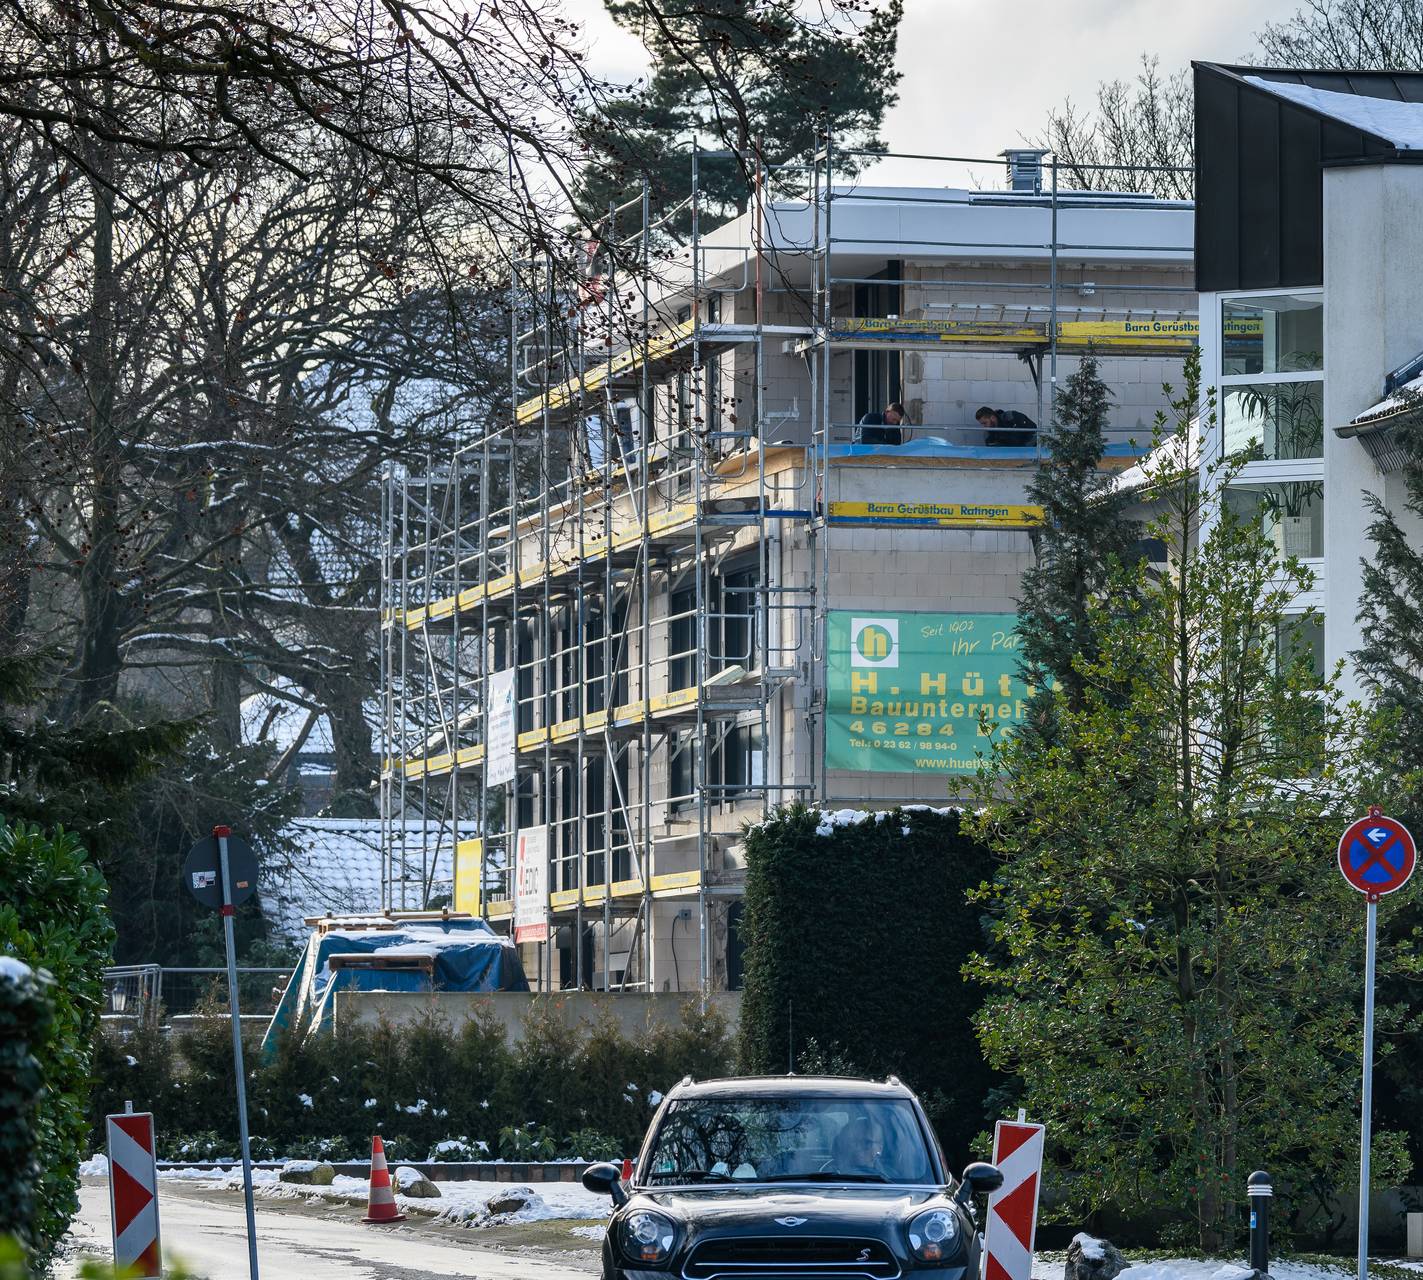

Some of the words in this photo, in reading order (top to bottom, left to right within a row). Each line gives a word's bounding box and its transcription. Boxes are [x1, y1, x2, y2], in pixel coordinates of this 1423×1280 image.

[1125, 322, 1150, 332] Bara
[1153, 321, 1199, 332] Gerüstba
[867, 502, 894, 513] Bara
[897, 503, 954, 515] Gerüstbau
[960, 505, 1009, 517] Ratingen
[920, 624, 944, 638] Seit
[952, 638, 980, 656] Ihr
[992, 631, 1024, 651] Par
[851, 671, 900, 695] H.
[850, 696, 1027, 719] Bauunterneh
[849, 720, 954, 737] 46284
[874, 740, 881, 748] 0
[883, 740, 896, 749] 23
[898, 741, 911, 749] 62
